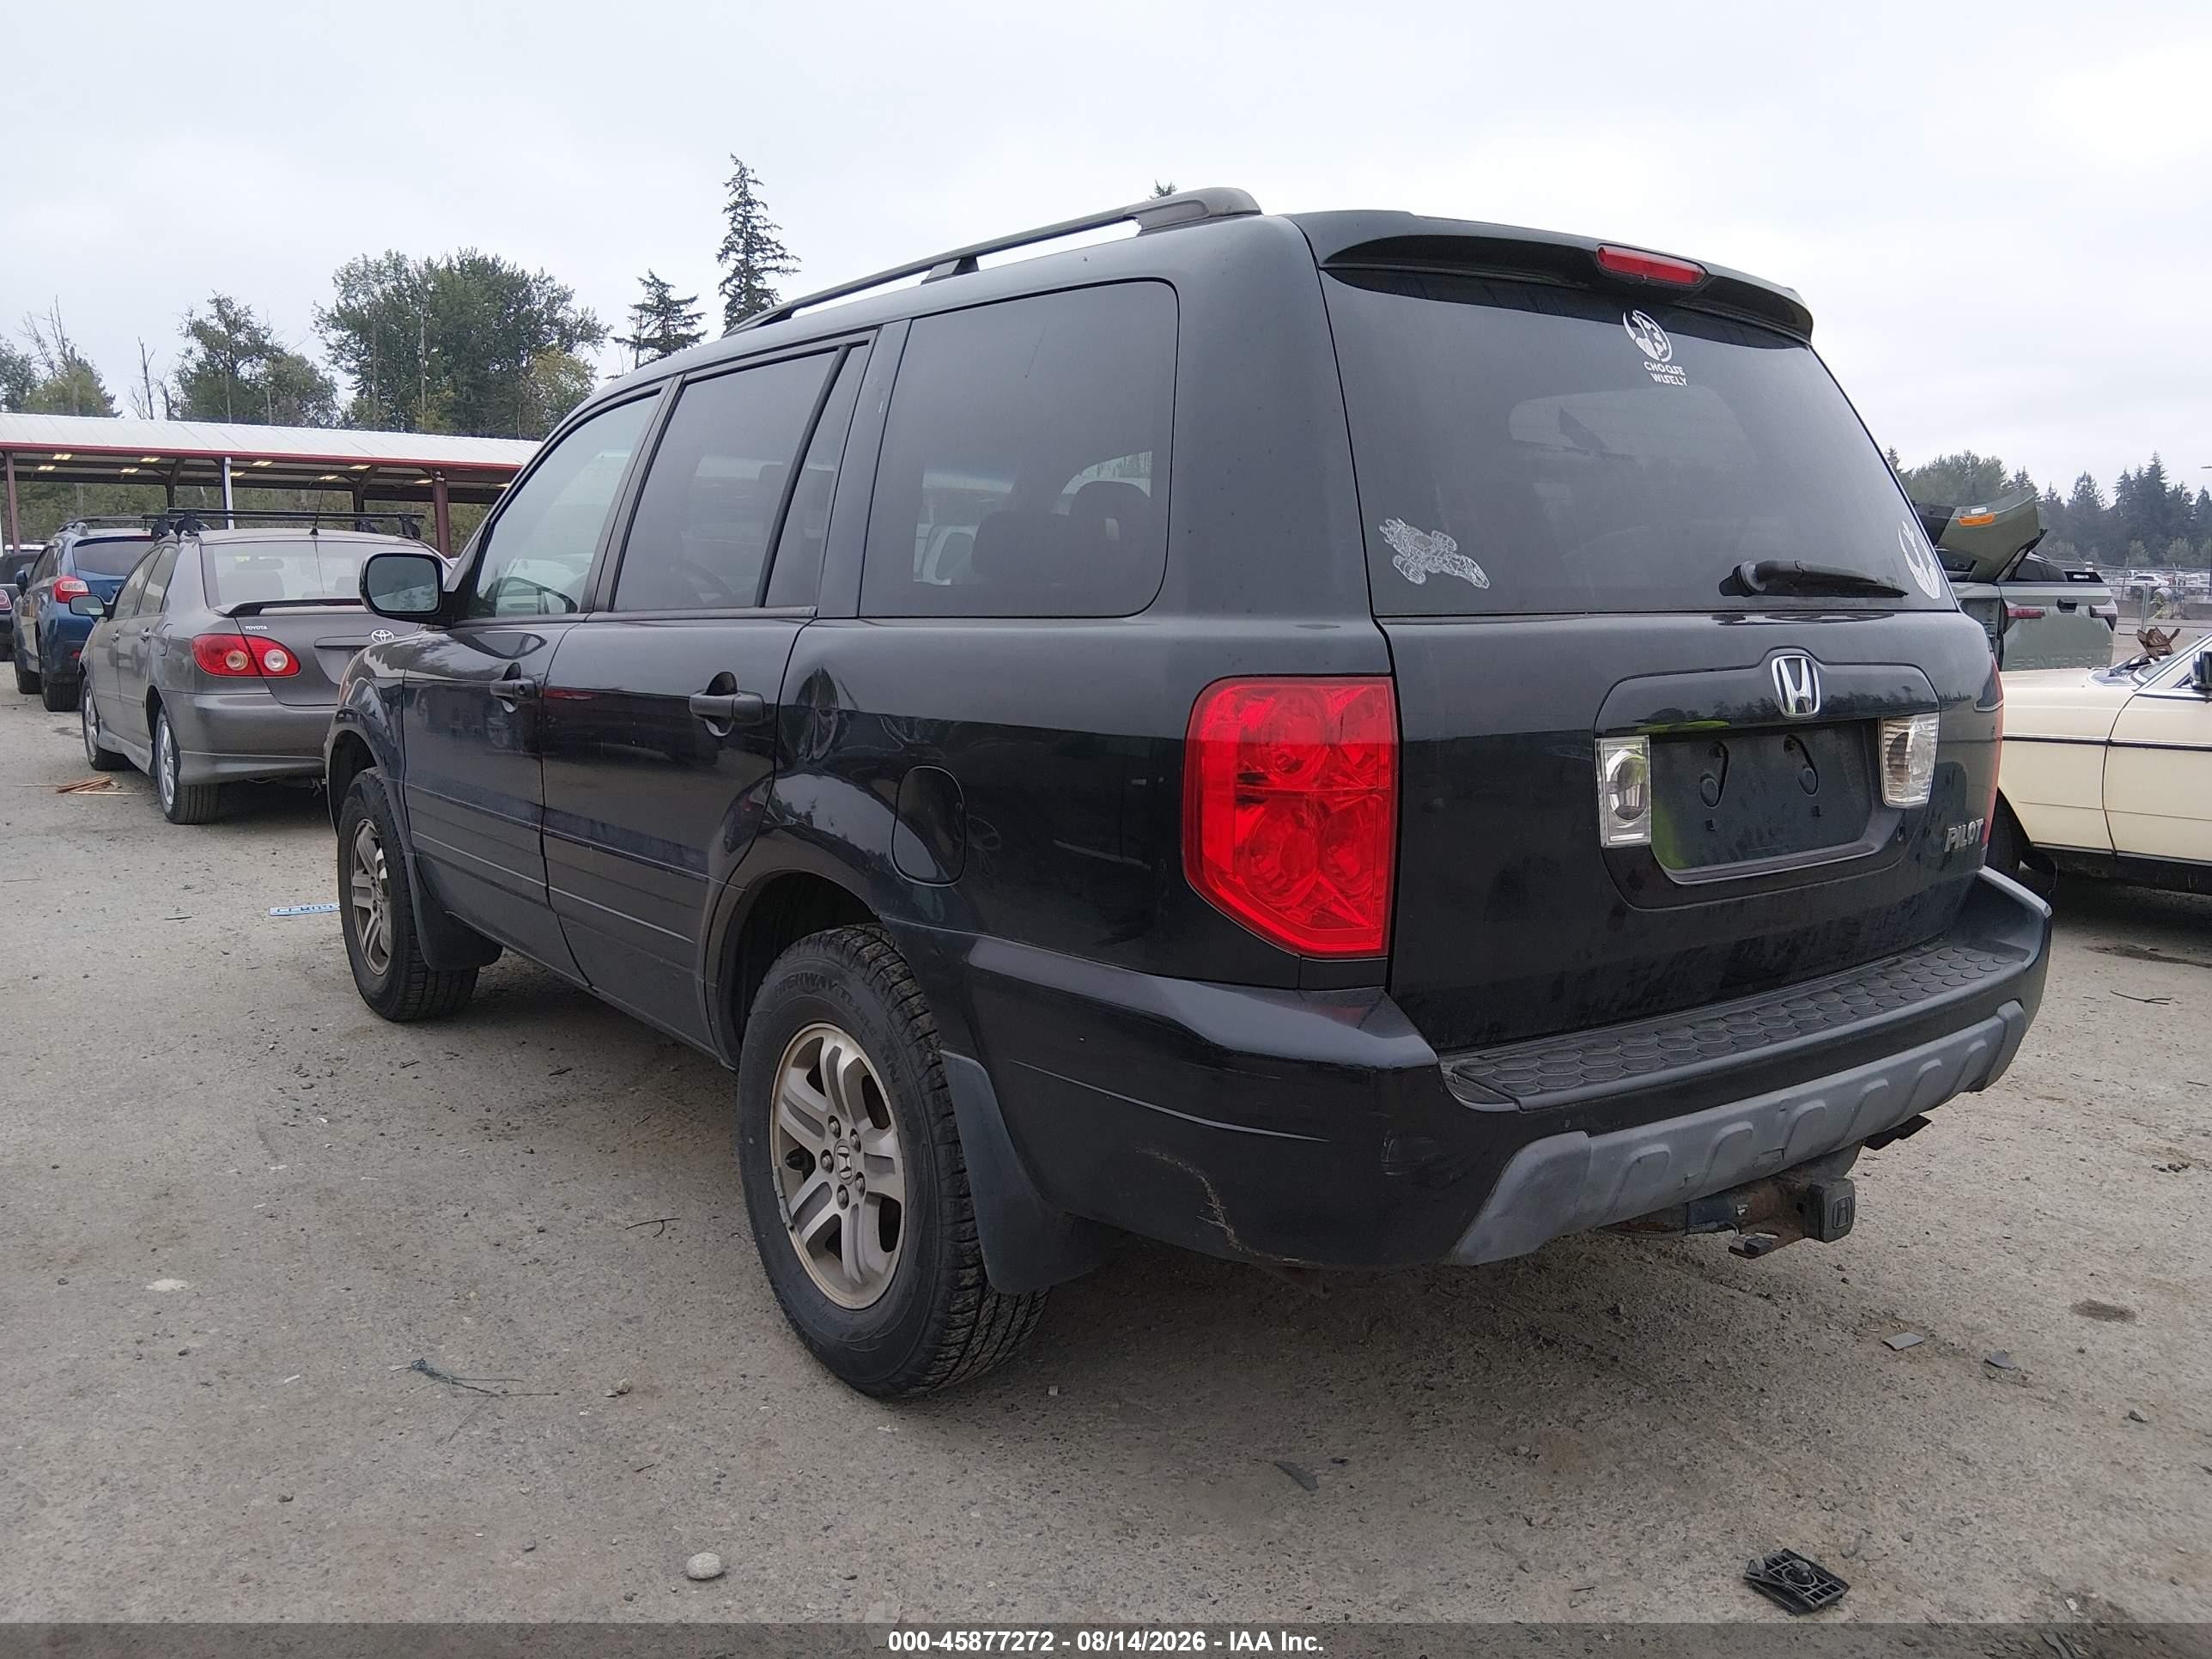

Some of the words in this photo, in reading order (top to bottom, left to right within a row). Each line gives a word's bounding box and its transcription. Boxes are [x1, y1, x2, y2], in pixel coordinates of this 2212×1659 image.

[1643, 361, 1686, 376] CHOOSE
[1650, 373, 1689, 386] WISELY
[1944, 817, 1984, 853] PILOT
